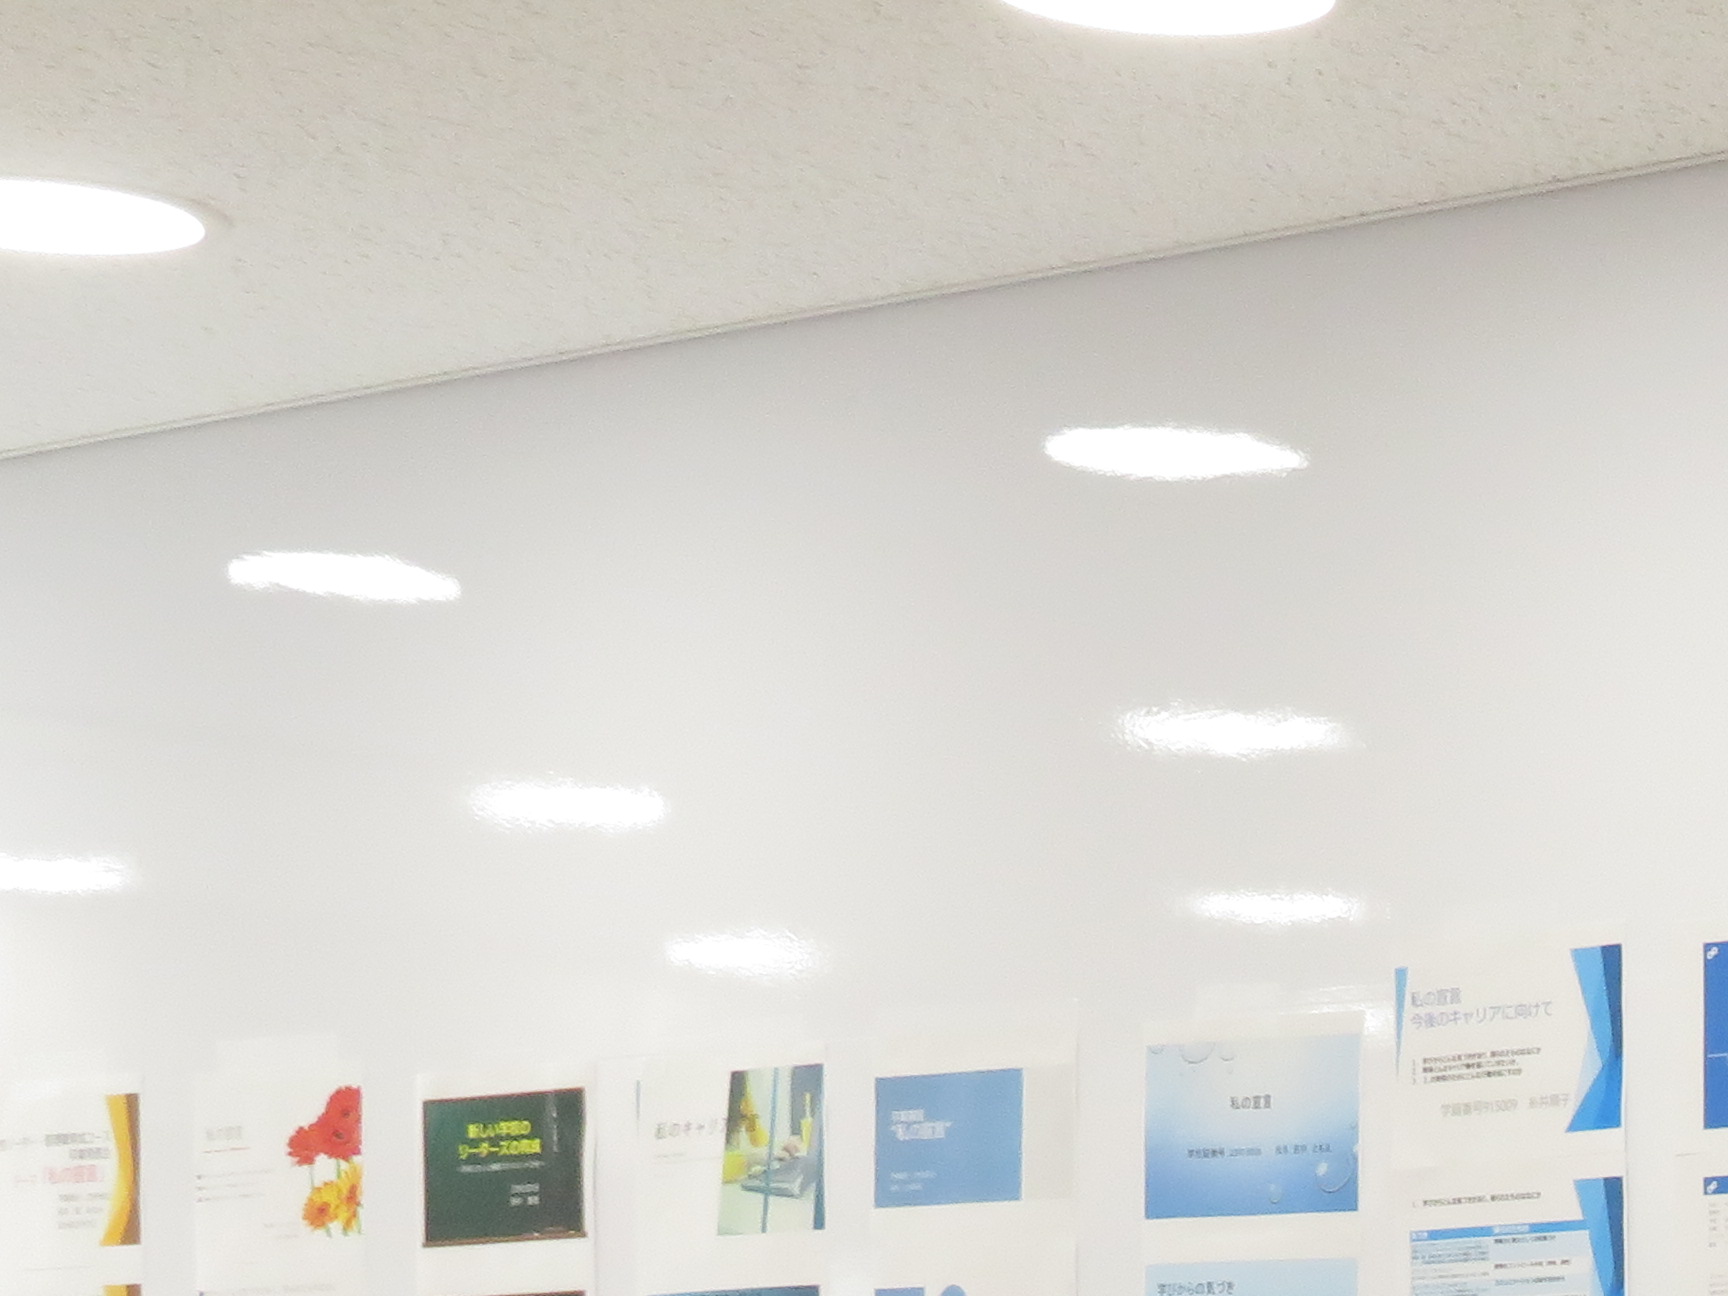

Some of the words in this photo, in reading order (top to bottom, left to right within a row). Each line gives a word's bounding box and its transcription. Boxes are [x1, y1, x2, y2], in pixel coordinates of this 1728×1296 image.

[1411, 1001, 1553, 1030] 今後のキャリアに向けて
